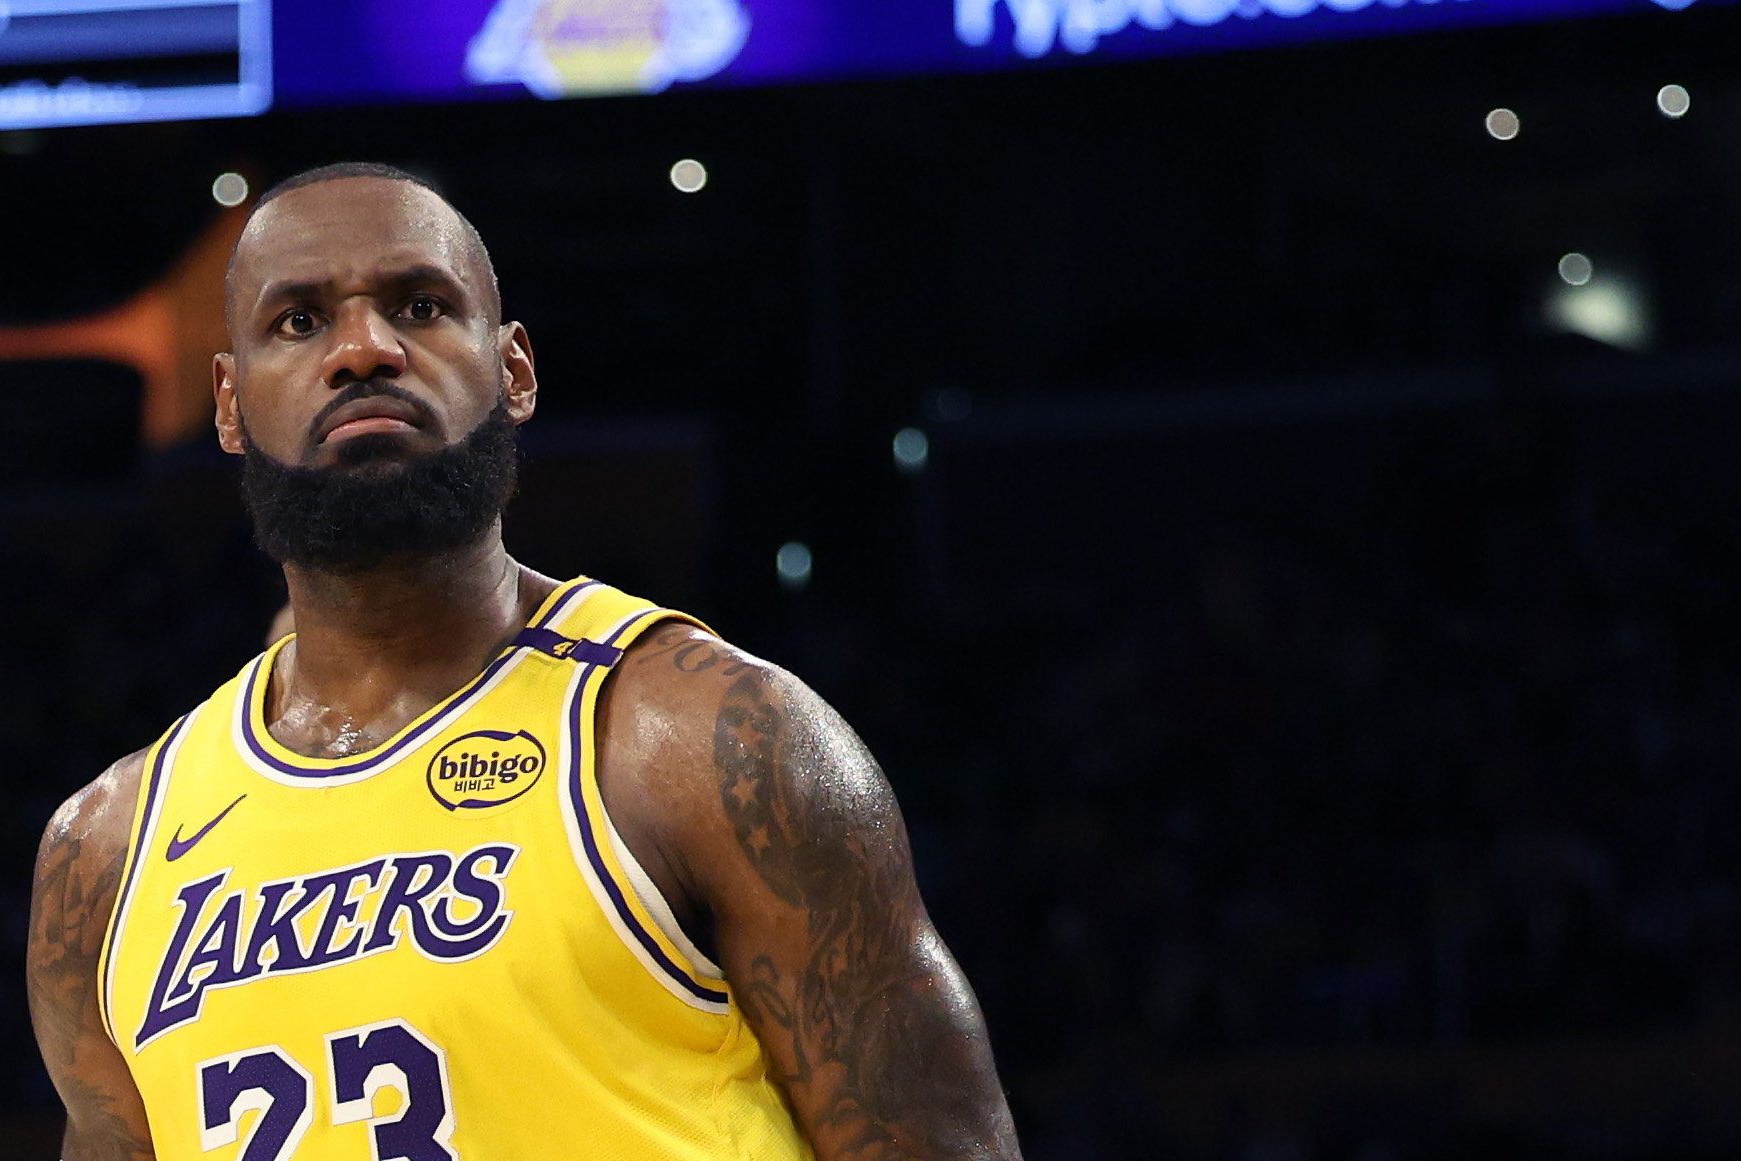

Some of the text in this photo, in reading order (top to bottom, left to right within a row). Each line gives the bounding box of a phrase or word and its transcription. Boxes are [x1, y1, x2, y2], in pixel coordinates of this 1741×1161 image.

[439, 751, 539, 783] bibigo
[453, 778, 495, 793] 비비고
[134, 841, 521, 1055] LAKERS
